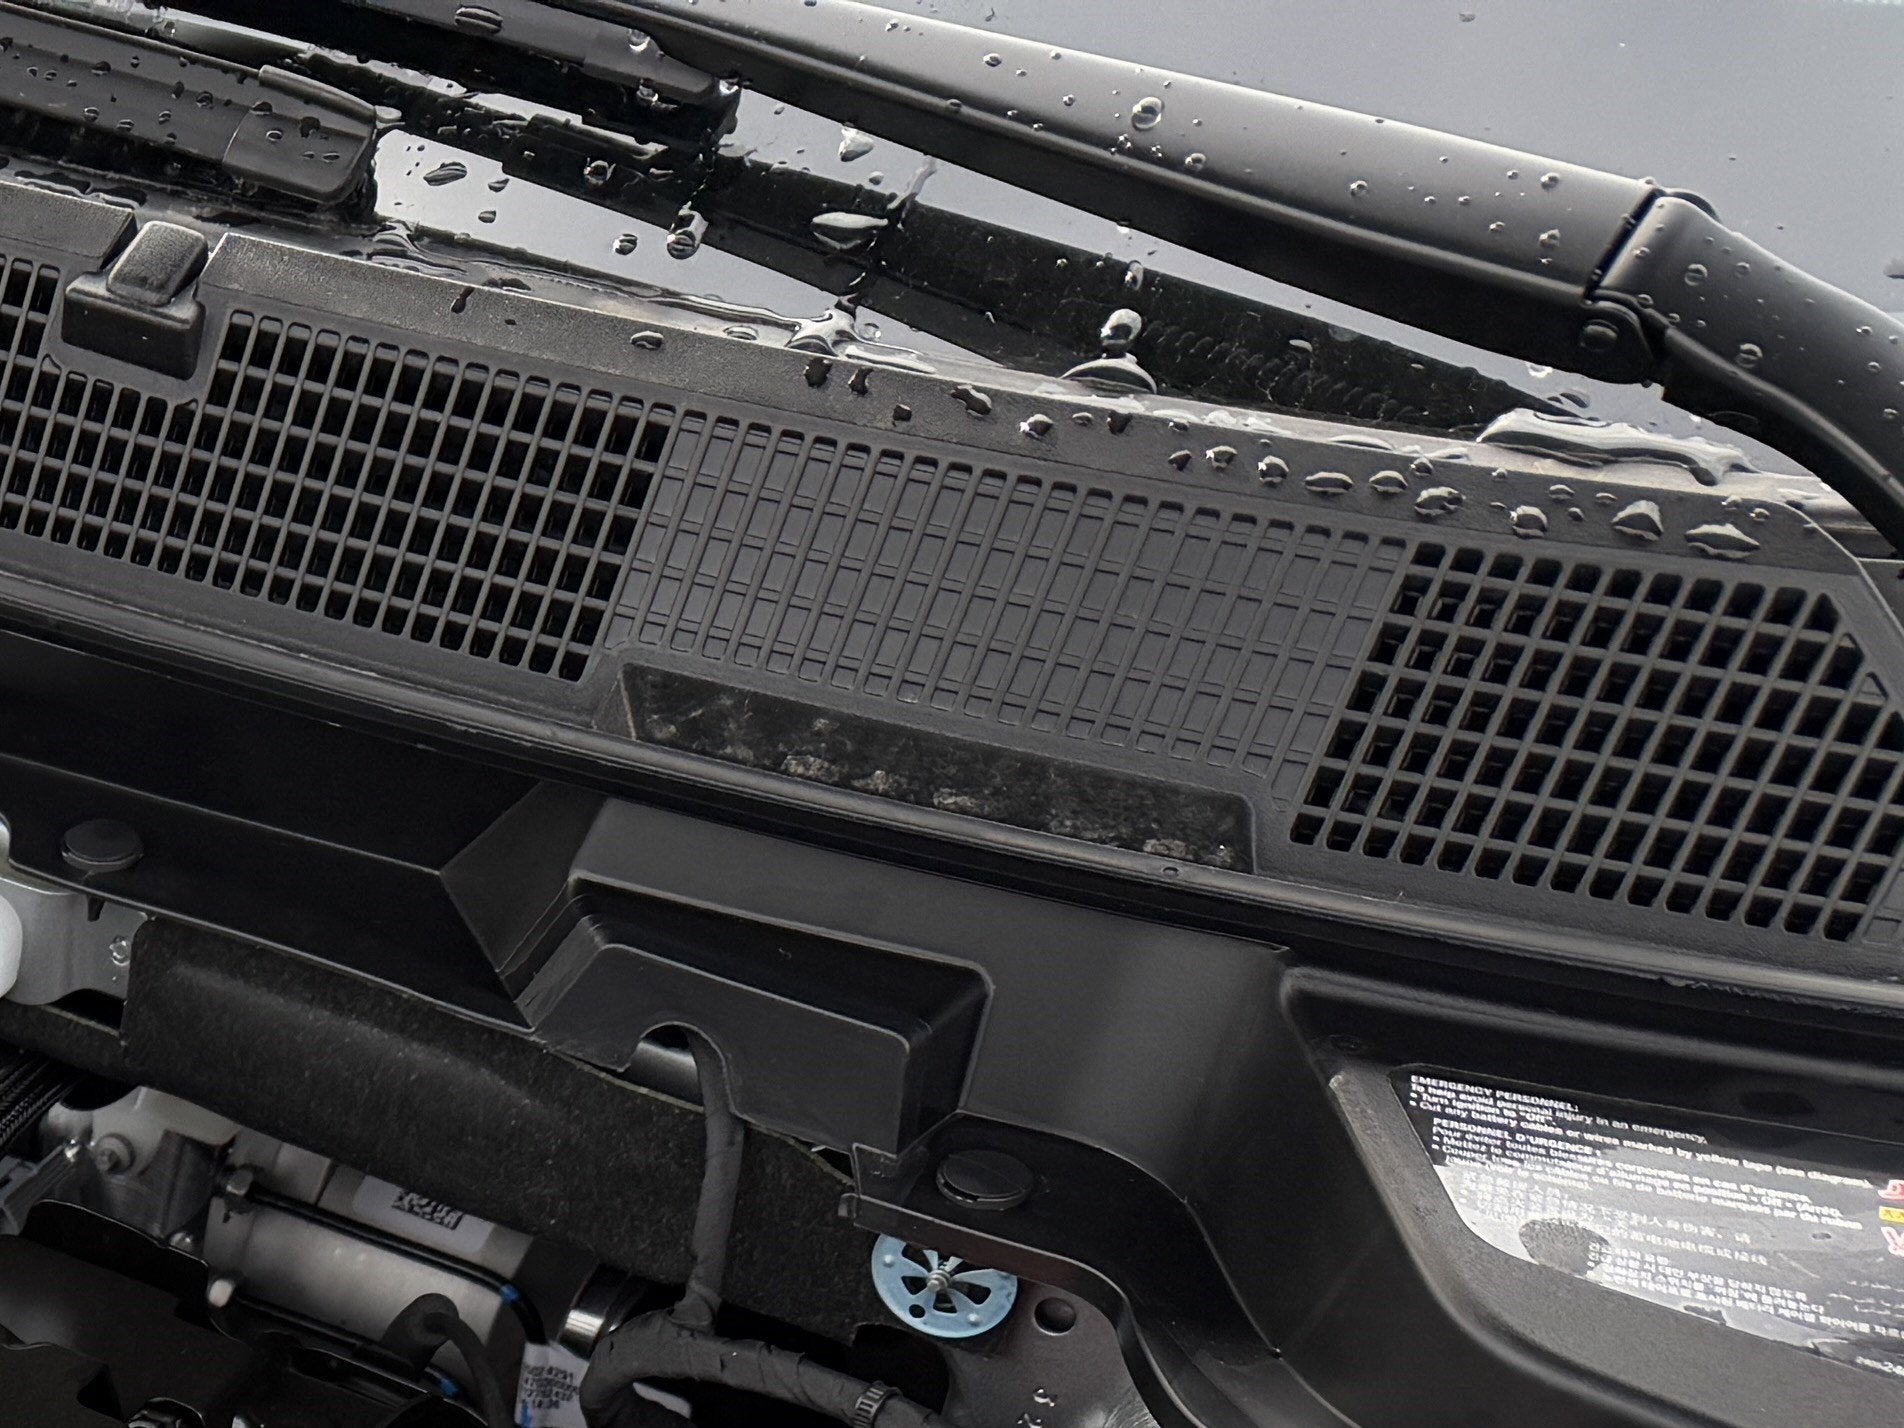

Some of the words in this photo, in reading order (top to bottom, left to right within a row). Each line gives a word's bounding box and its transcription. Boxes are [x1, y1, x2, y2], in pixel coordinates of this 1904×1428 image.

[1411, 1075, 1493, 1095] EMERGENCY
[1422, 1093, 1449, 1104] Turn
[1429, 1086, 1456, 1098] help
[1460, 1092, 1494, 1105] avoid
[1497, 1100, 1552, 1116] personal
[1556, 1109, 1592, 1124] injury
[1420, 1101, 1441, 1112] Cut
[1446, 1107, 1468, 1119] any
[1471, 1111, 1517, 1127] battery
[1520, 1121, 1563, 1136] cables
[1585, 1132, 1619, 1146] wires
[1433, 1118, 1512, 1140] PERSONNEL
[1516, 1134, 1593, 1154] D'URGENCE
